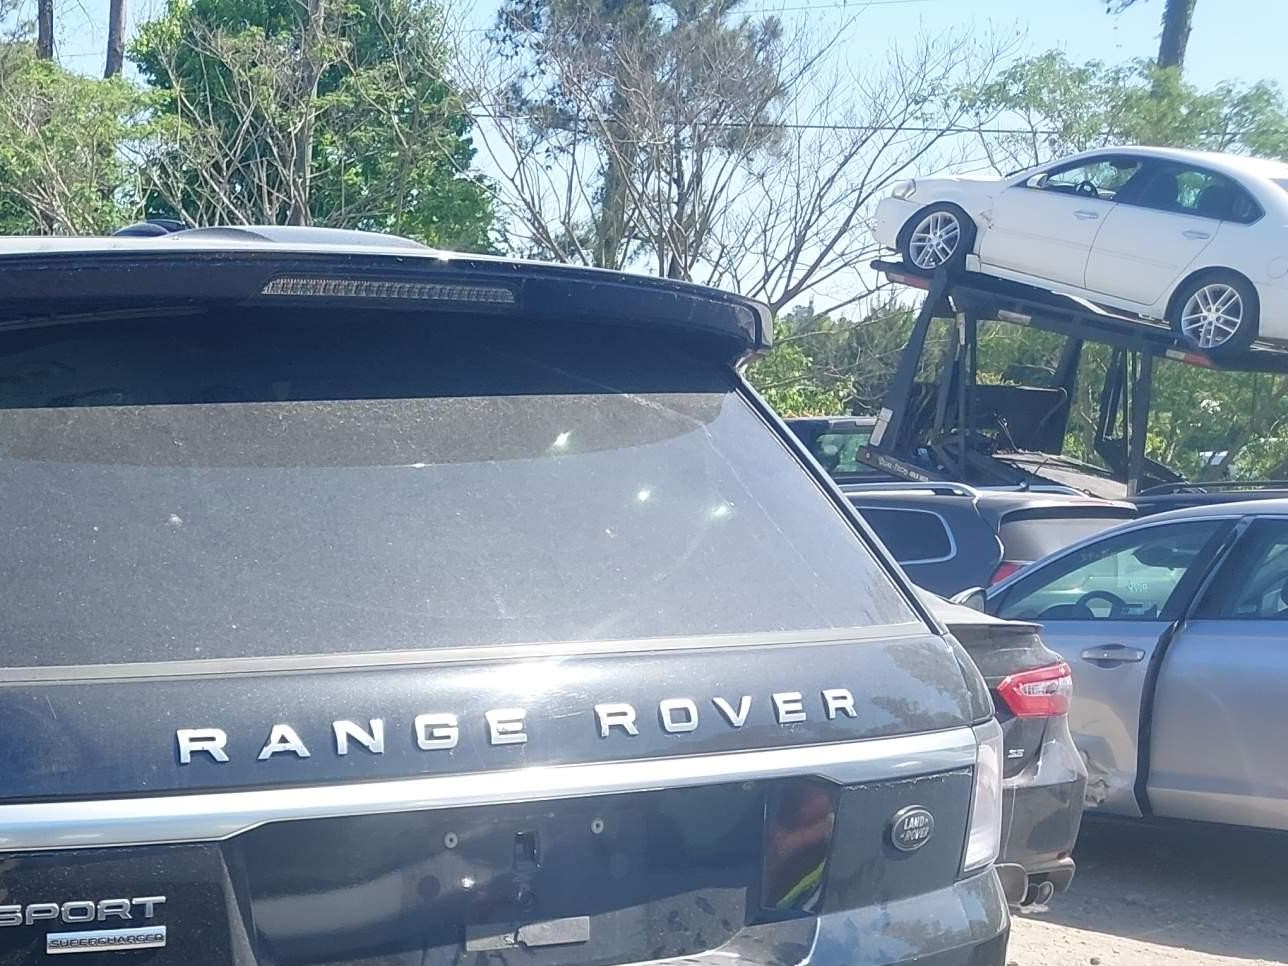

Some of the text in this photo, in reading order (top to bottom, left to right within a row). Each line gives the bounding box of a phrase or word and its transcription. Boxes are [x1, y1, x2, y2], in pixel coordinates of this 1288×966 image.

[177, 688, 858, 764] RANGE ROVER
[904, 816, 925, 830] LAND
[904, 826, 930, 842] ROVER
[48, 932, 164, 950] SUPERCHARGED
